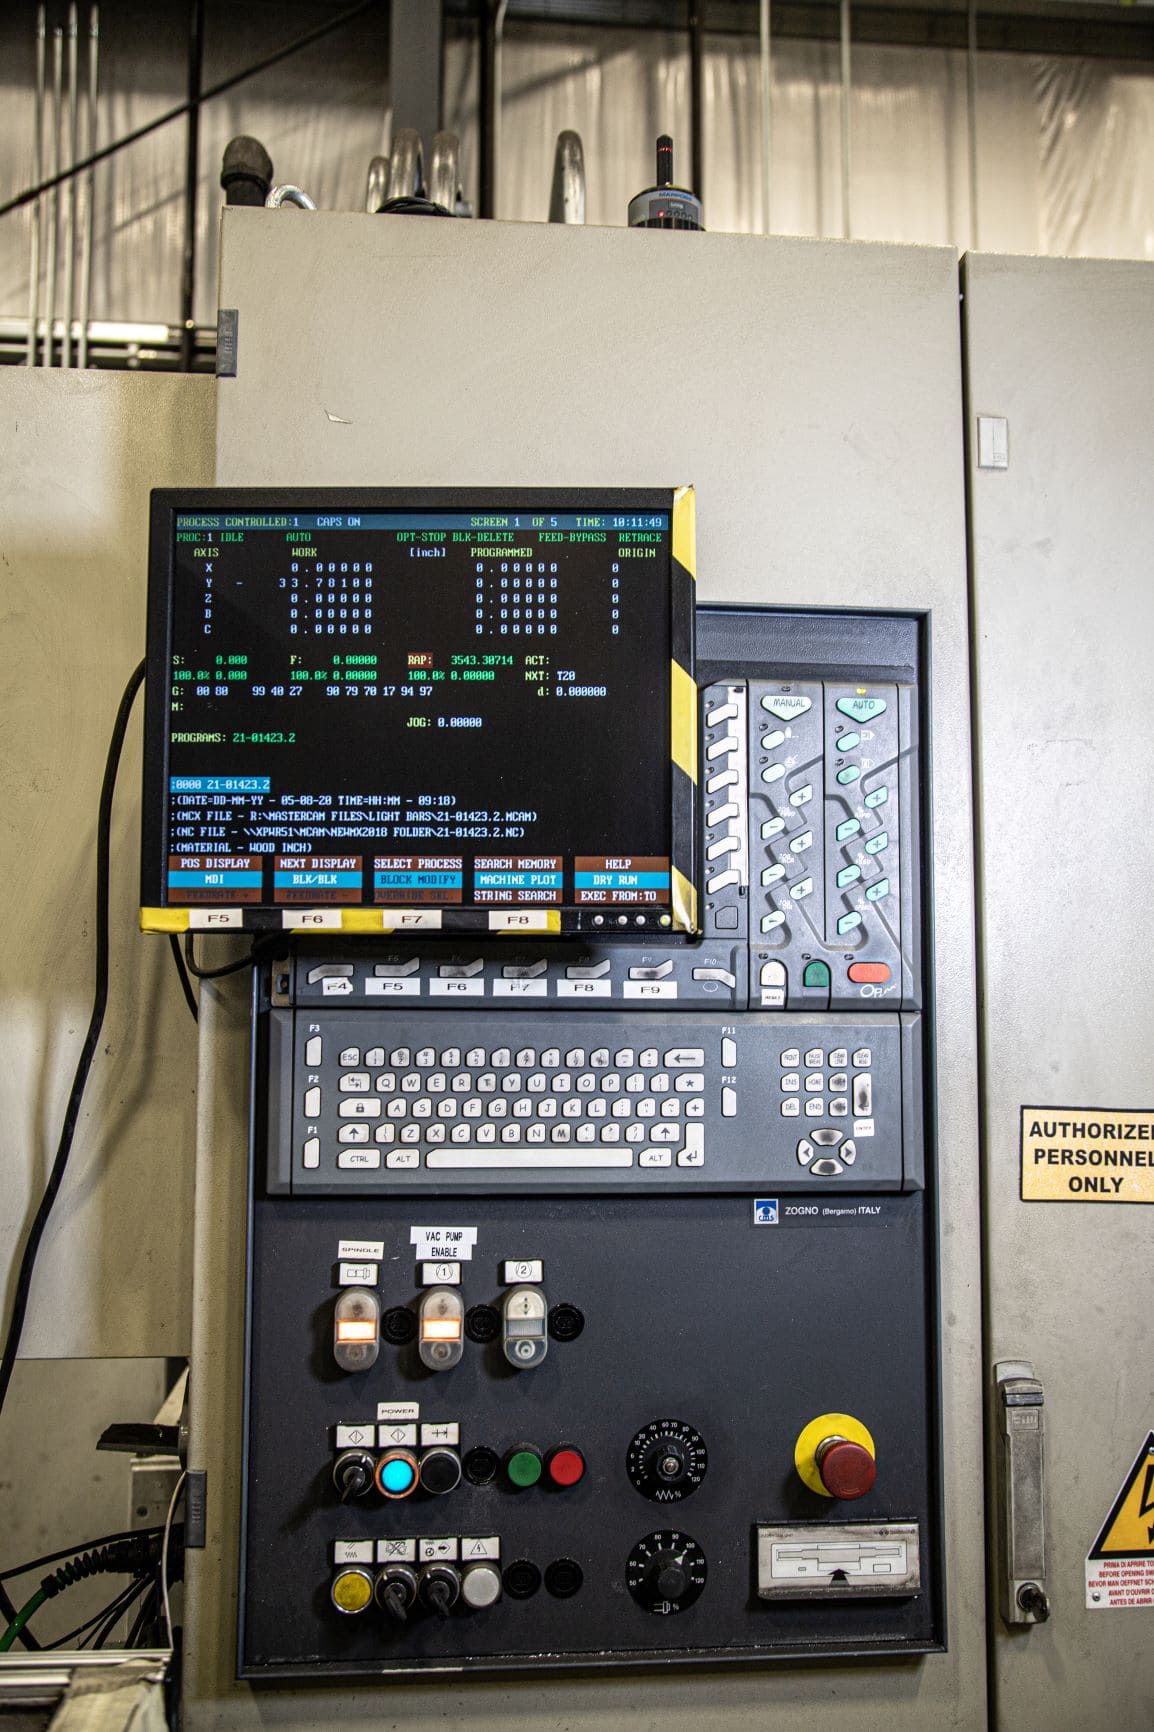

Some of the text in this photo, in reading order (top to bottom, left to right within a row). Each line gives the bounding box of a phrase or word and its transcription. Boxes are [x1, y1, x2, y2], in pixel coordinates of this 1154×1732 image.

[176, 517, 299, 527] PROCESS CONTROLLED:1
[317, 517, 361, 527] CAPS ON
[470, 517, 558, 527] SCREEN 1 OF 5
[575, 517, 662, 527] TIME: 10:11:49
[176, 533, 244, 542] PROC:1 IDLE
[286, 533, 312, 542] AUTO
[396, 533, 514, 543] OPT-STOP BLK-DELETE
[538, 533, 607, 543] FEED-BYPASS
[618, 533, 662, 543] RETRACE
[193, 547, 219, 558] AXIS
[291, 547, 317, 558] WORK
[409, 547, 447, 558] [inch]
[470, 547, 533, 558] PROGRAMMED
[618, 547, 656, 558] ORIGIN
[205, 563, 213, 572] X
[206, 578, 213, 588] Y
[204, 593, 212, 603] Z
[204, 609, 212, 619] B
[204, 624, 212, 634] C
[172, 655, 185, 665] S:
[216, 655, 248, 665] 0.000
[290, 655, 302, 665] F:
[408, 655, 432, 665] RAP:
[451, 655, 514, 666] 3543.30714
[525, 655, 550, 666] ACT:
[173, 671, 248, 681] 100.0% 0.000
[290, 671, 327, 681] 100.0%
[408, 671, 445, 681] 100.0%
[525, 671, 576, 681] NXT: T20
[172, 686, 433, 696] G: 99 40 27 90 79 70 17 94 97
[537, 686, 550, 696] d:
[171, 702, 183, 711] M:
[773, 699, 805, 707] MANUAL
[852, 700, 875, 709] AUTO
[407, 717, 432, 728] JOG:
[171, 733, 296, 743] PROGRAMS: 21-01423.2
[207, 780, 270, 790] 21-01423.2
[281, 795, 332, 806] 05-08-20
[337, 795, 401, 806] TIME=HH:MM
[207, 811, 232, 821] FILE
[331, 811, 400, 822] FILES\LIGHT
[200, 826, 226, 837] FILE
[249, 842, 275, 853] WOOD
[282, 842, 312, 854] INCH)
[181, 859, 250, 868] POS DISPLAY
[280, 859, 356, 869] NEXT DISPLAY
[374, 859, 463, 869] SELECT PROCESS
[474, 859, 556, 870] SEARCH MEMORY
[605, 859, 631, 869] HELP
[205, 875, 224, 884] MDI
[293, 875, 337, 885] BLK/BLK
[380, 875, 456, 885] BLOCK MODIFY
[480, 875, 556, 885] MACHINE PLOT
[593, 875, 637, 885] DRY RUN
[473, 891, 556, 901] STRING SEARCH
[581, 891, 656, 901] EXEC FROM:TO
[207, 914, 229, 924] F5
[302, 915, 323, 924] F6
[401, 915, 422, 924] F7
[507, 916, 529, 924] F8
[327, 982, 347, 991] F4
[447, 983, 467, 991] F6
[574, 984, 594, 992] F8
[640, 986, 660, 994] F9
[1029, 1121, 1154, 1140] AUTHORIZE
[350, 1155, 369, 1163] CTRL
[1068, 1176, 1124, 1193] ONLY
[785, 1207, 818, 1215] ZOGNO
[822, 1207, 856, 1216] (Bergamo)
[858, 1207, 881, 1215] ITALY
[425, 1231, 463, 1242] VAC PUMP
[342, 1246, 379, 1254] SPINDLE
[431, 1247, 457, 1257] ENABLE
